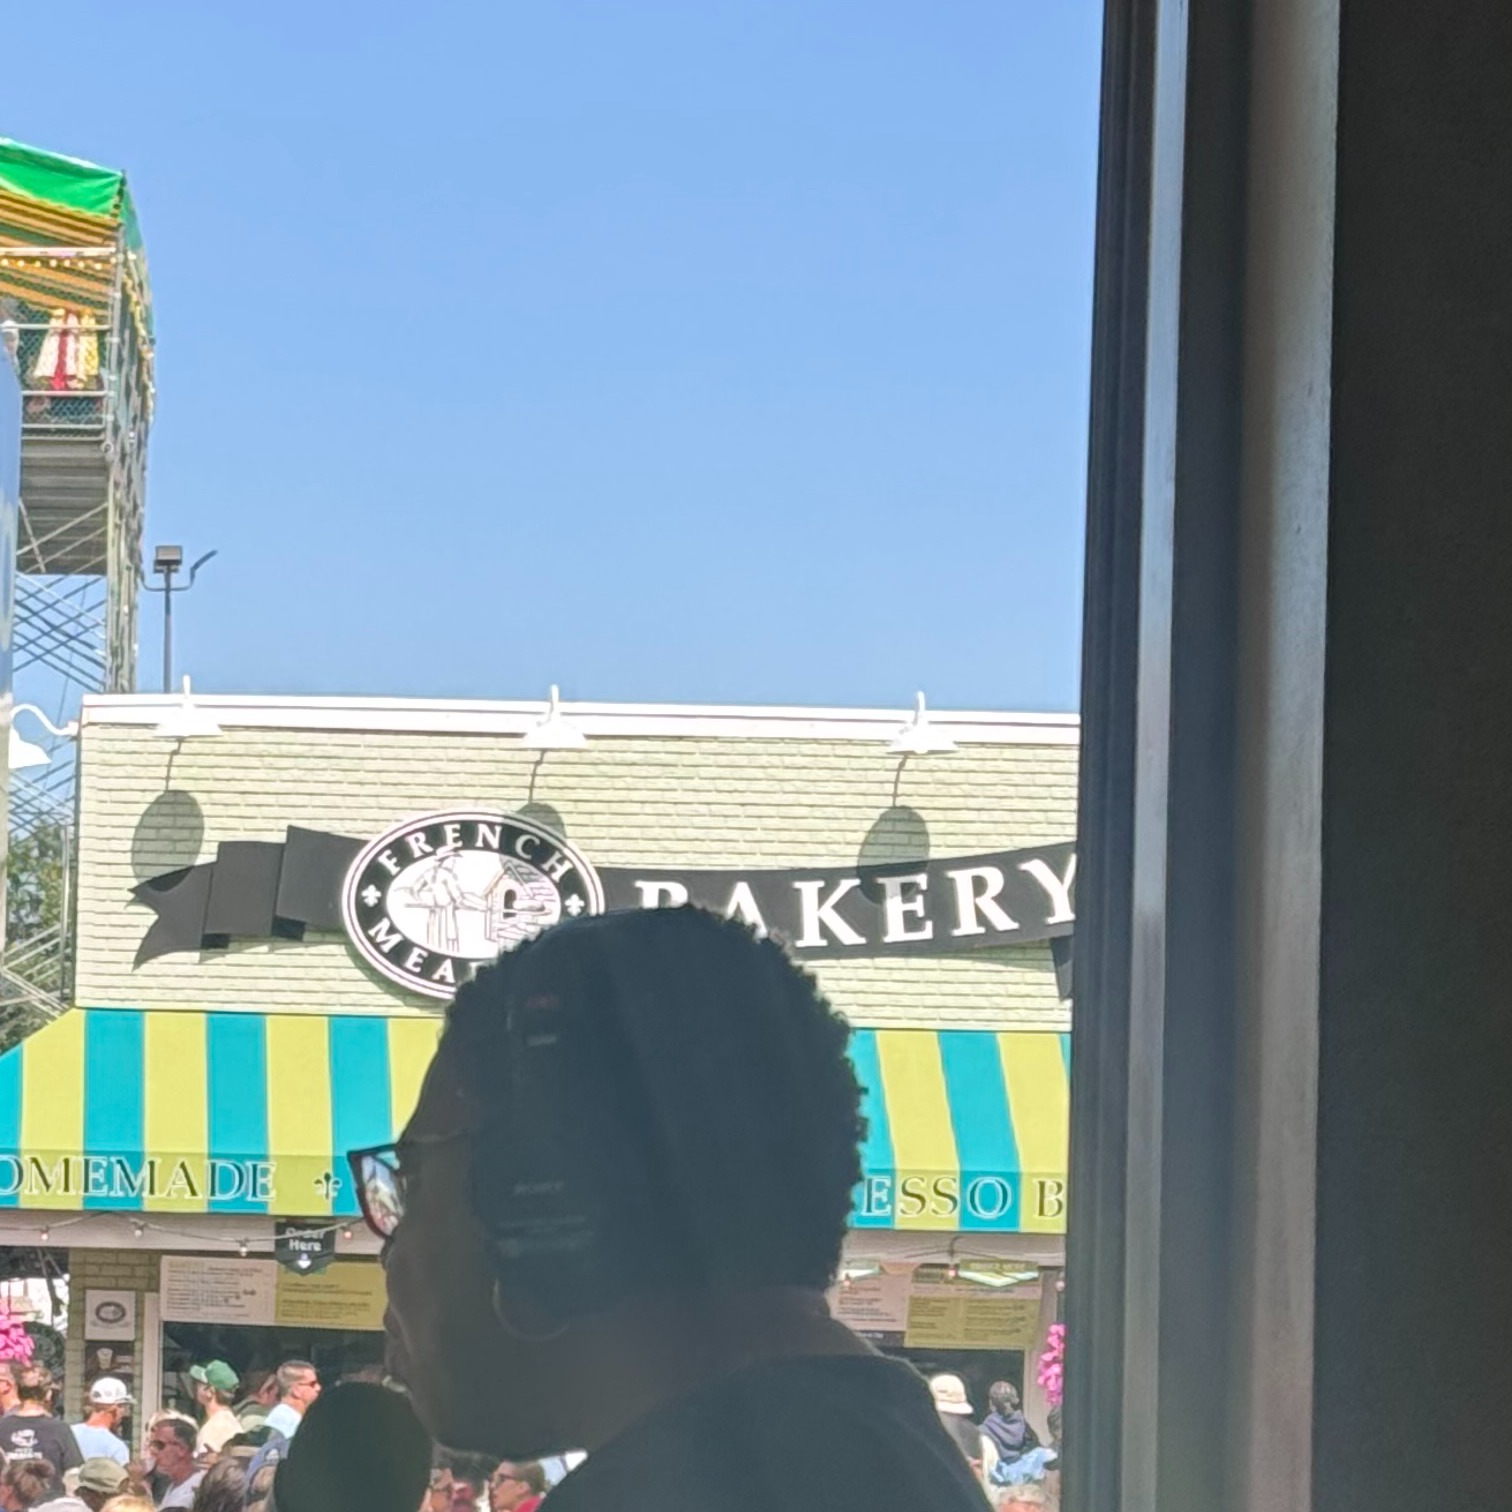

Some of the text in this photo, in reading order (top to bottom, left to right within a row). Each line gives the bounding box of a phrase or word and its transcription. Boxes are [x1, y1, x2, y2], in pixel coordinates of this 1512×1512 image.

[378, 822, 573, 883] FRENCH
[367, 917, 483, 984] MEA
[860, 1174, 1013, 1219] ESSO
[288, 1239, 322, 1252] Here
